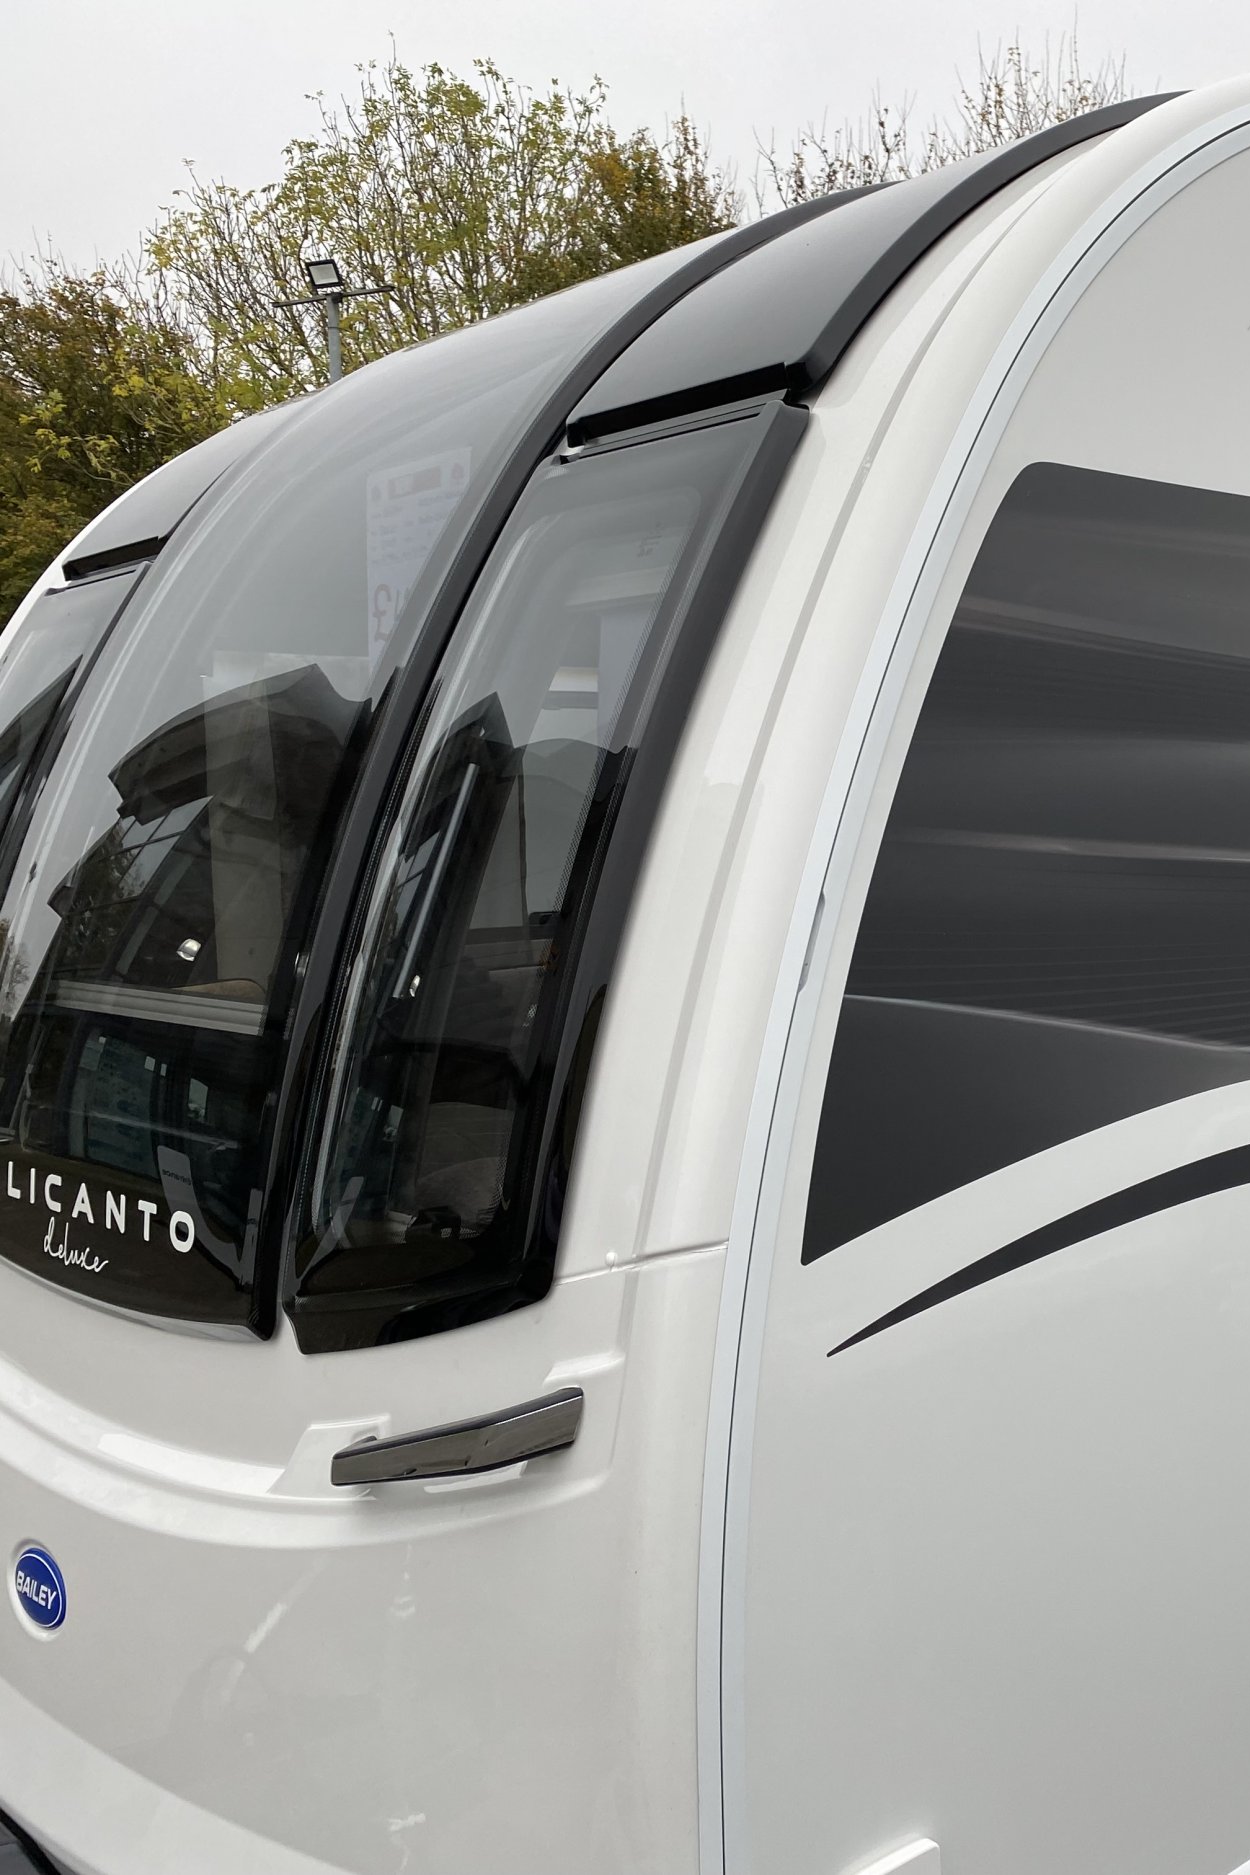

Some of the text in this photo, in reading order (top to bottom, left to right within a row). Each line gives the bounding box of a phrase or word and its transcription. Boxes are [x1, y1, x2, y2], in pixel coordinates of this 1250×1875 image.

[7, 1160, 196, 1253] LICANTO
[43, 1217, 109, 1273] deluxe
[16, 1570, 57, 1610] BAILEY
